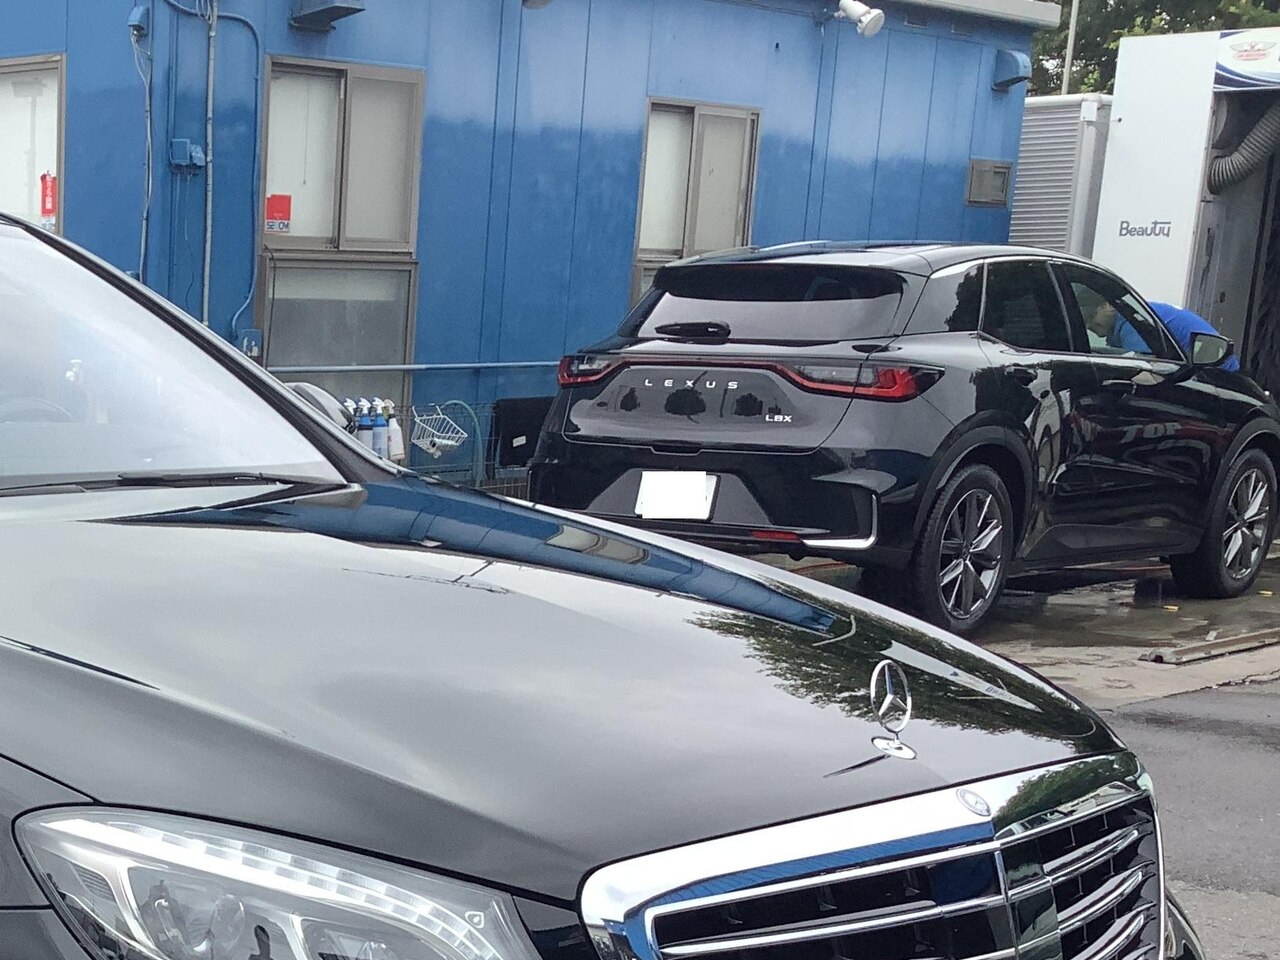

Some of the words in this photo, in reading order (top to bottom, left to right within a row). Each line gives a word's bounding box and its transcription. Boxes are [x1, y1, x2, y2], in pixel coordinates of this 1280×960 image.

[1119, 220, 1171, 238] Beauty
[644, 378, 739, 389] LEXUS
[765, 414, 793, 423] LBX
